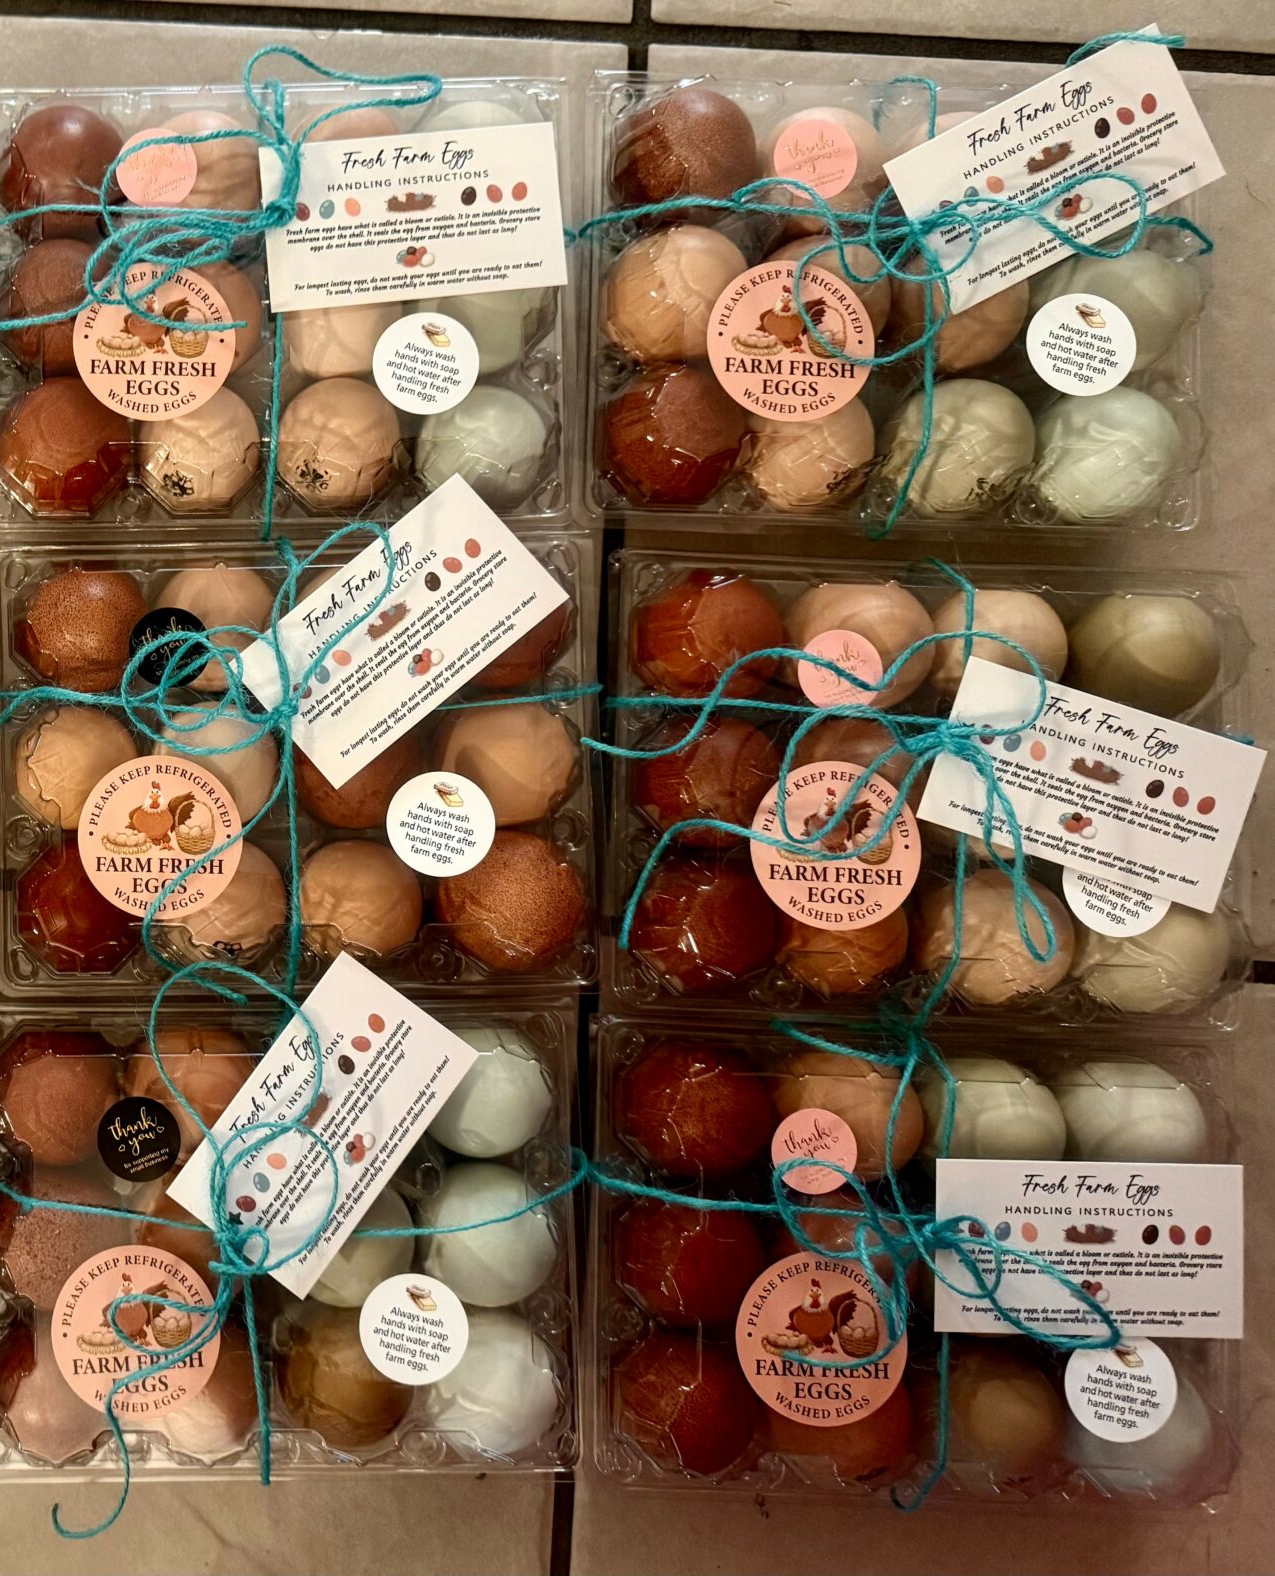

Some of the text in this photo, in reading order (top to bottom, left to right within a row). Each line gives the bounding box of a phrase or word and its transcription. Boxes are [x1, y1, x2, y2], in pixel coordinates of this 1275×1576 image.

[966, 79, 1092, 156] Fresh Farm Eggs
[963, 95, 1114, 179] HANDLING INSTRUCTIONS
[340, 140, 474, 174] Fresh Farm Eggs
[326, 169, 488, 192] HANDLING INSTRUCTIONS
[718, 270, 782, 327] PLEASE KEEP
[90, 359, 217, 377] FARM FRESH
[725, 357, 782, 375] FARM
[126, 380, 180, 396] EGGS
[762, 379, 818, 396] EGGS
[108, 389, 197, 413] WASHED EGGS
[743, 388, 836, 413] WASHED EGGS
[302, 569, 379, 635] Fresh Farm
[1043, 695, 1179, 760] Fresh Farm Eggs
[1091, 742, 1184, 778] INSTRUCTIONS
[793, 772, 826, 791] KEEP
[89, 765, 231, 829] PLEASE KEEP REFRIGERATED
[96, 857, 153, 873] FARM
[769, 864, 902, 885] FARM FRESH
[172, 890, 205, 911] EGGS
[807, 887, 865, 905] EGGS
[789, 897, 882, 923] WASHED EGGS
[258, 1062, 294, 1101] Farm
[1021, 1173, 1160, 1206] Fresh Farm Eggs
[1004, 1205, 1173, 1217] HANDLING INSTRUCTIONS
[62, 1257, 120, 1327] PLEASE KEEP
[747, 1262, 810, 1327] PLEASE KEEP
[73, 1355, 130, 1375] FARM
[1096, 1365, 1152, 1384] Always wash
[154, 1385, 187, 1410] EGGS
[794, 1382, 852, 1400] EGGS
[1080, 1386, 1160, 1409] and hot water after
[1087, 1373, 1157, 1398] hands with soap
[775, 1392, 870, 1419] WASHED EGGS
[1087, 1397, 1149, 1418] handling fresh
[1094, 1411, 1139, 1428] farm eggs.
